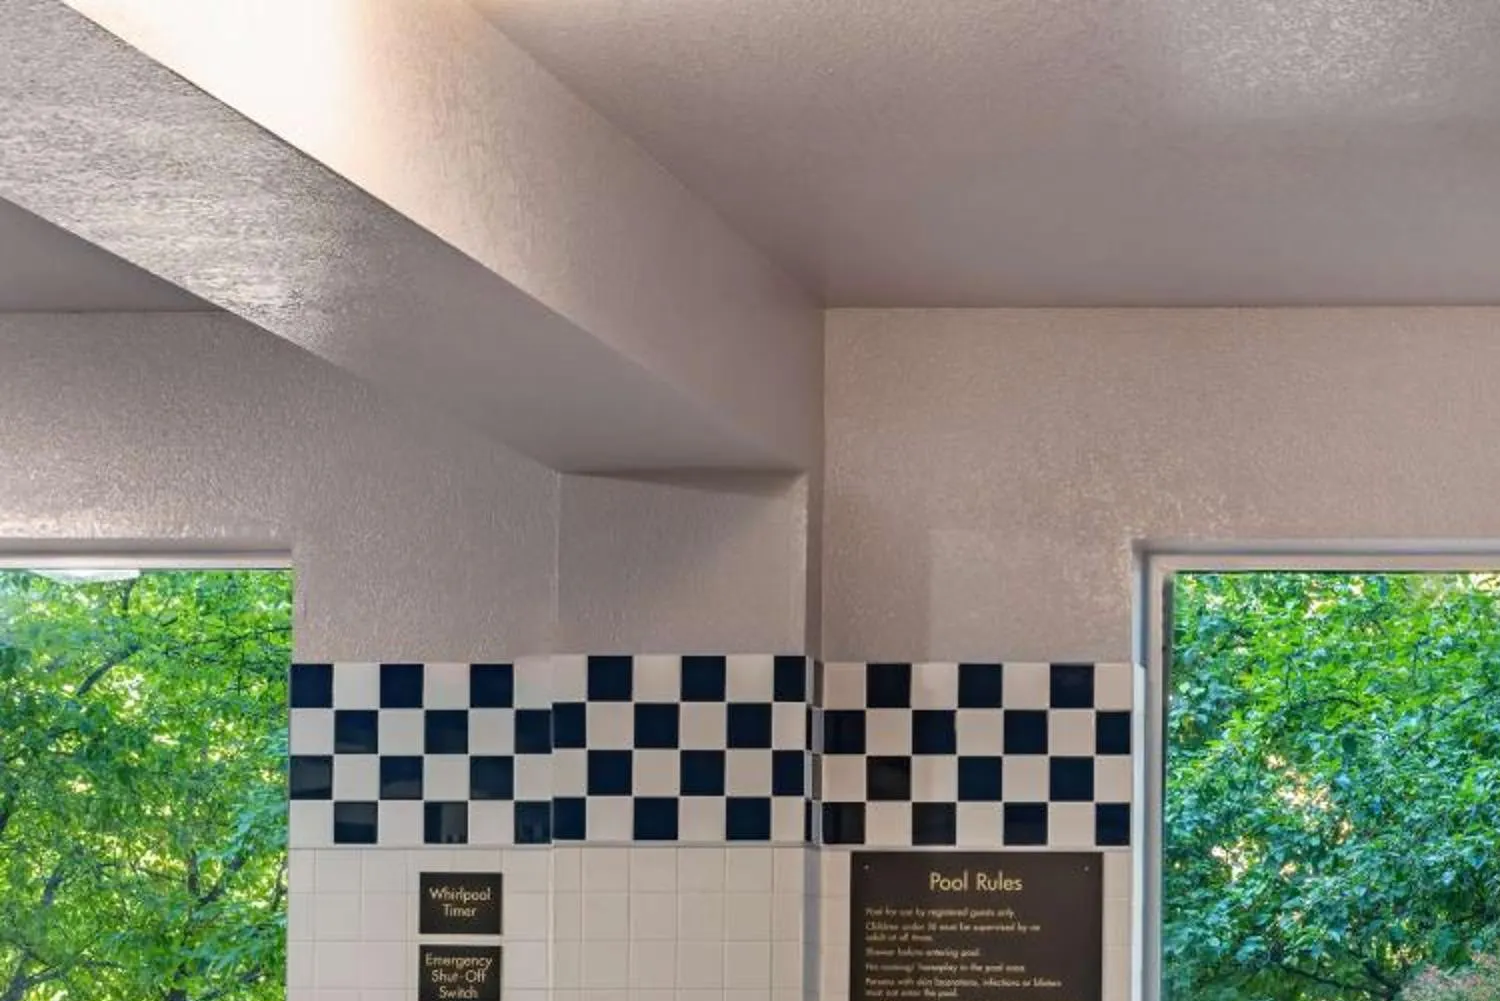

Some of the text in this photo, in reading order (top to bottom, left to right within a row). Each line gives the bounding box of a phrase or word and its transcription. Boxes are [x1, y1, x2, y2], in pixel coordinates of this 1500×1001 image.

[930, 870, 1023, 891] Pool Rules
[428, 886, 492, 904] Whirlpool
[442, 903, 477, 917] Timer
[425, 953, 492, 970] Emergency
[431, 969, 486, 982] Shut-Off
[439, 985, 478, 998] Switch
